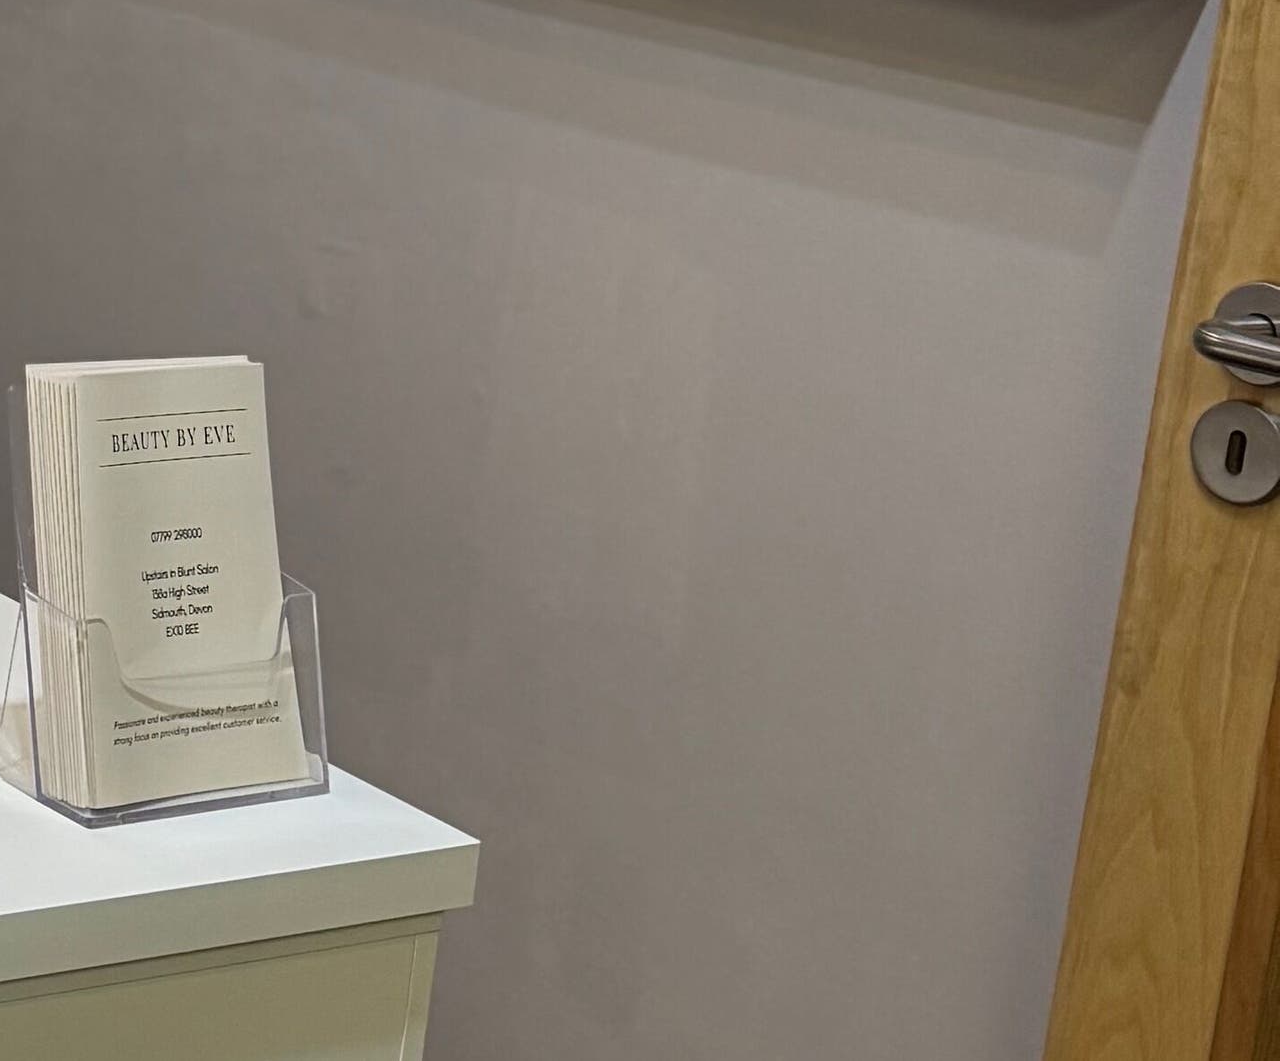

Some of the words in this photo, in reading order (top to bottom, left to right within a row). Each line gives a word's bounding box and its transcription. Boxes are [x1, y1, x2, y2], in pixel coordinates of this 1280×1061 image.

[112, 430, 170, 453] BEAUTY
[177, 427, 196, 447] BY
[204, 424, 236, 445] EVE
[196, 562, 219, 576] Salon
[168, 585, 185, 600] High
[186, 584, 209, 596] Street
[188, 604, 213, 616] Devon
